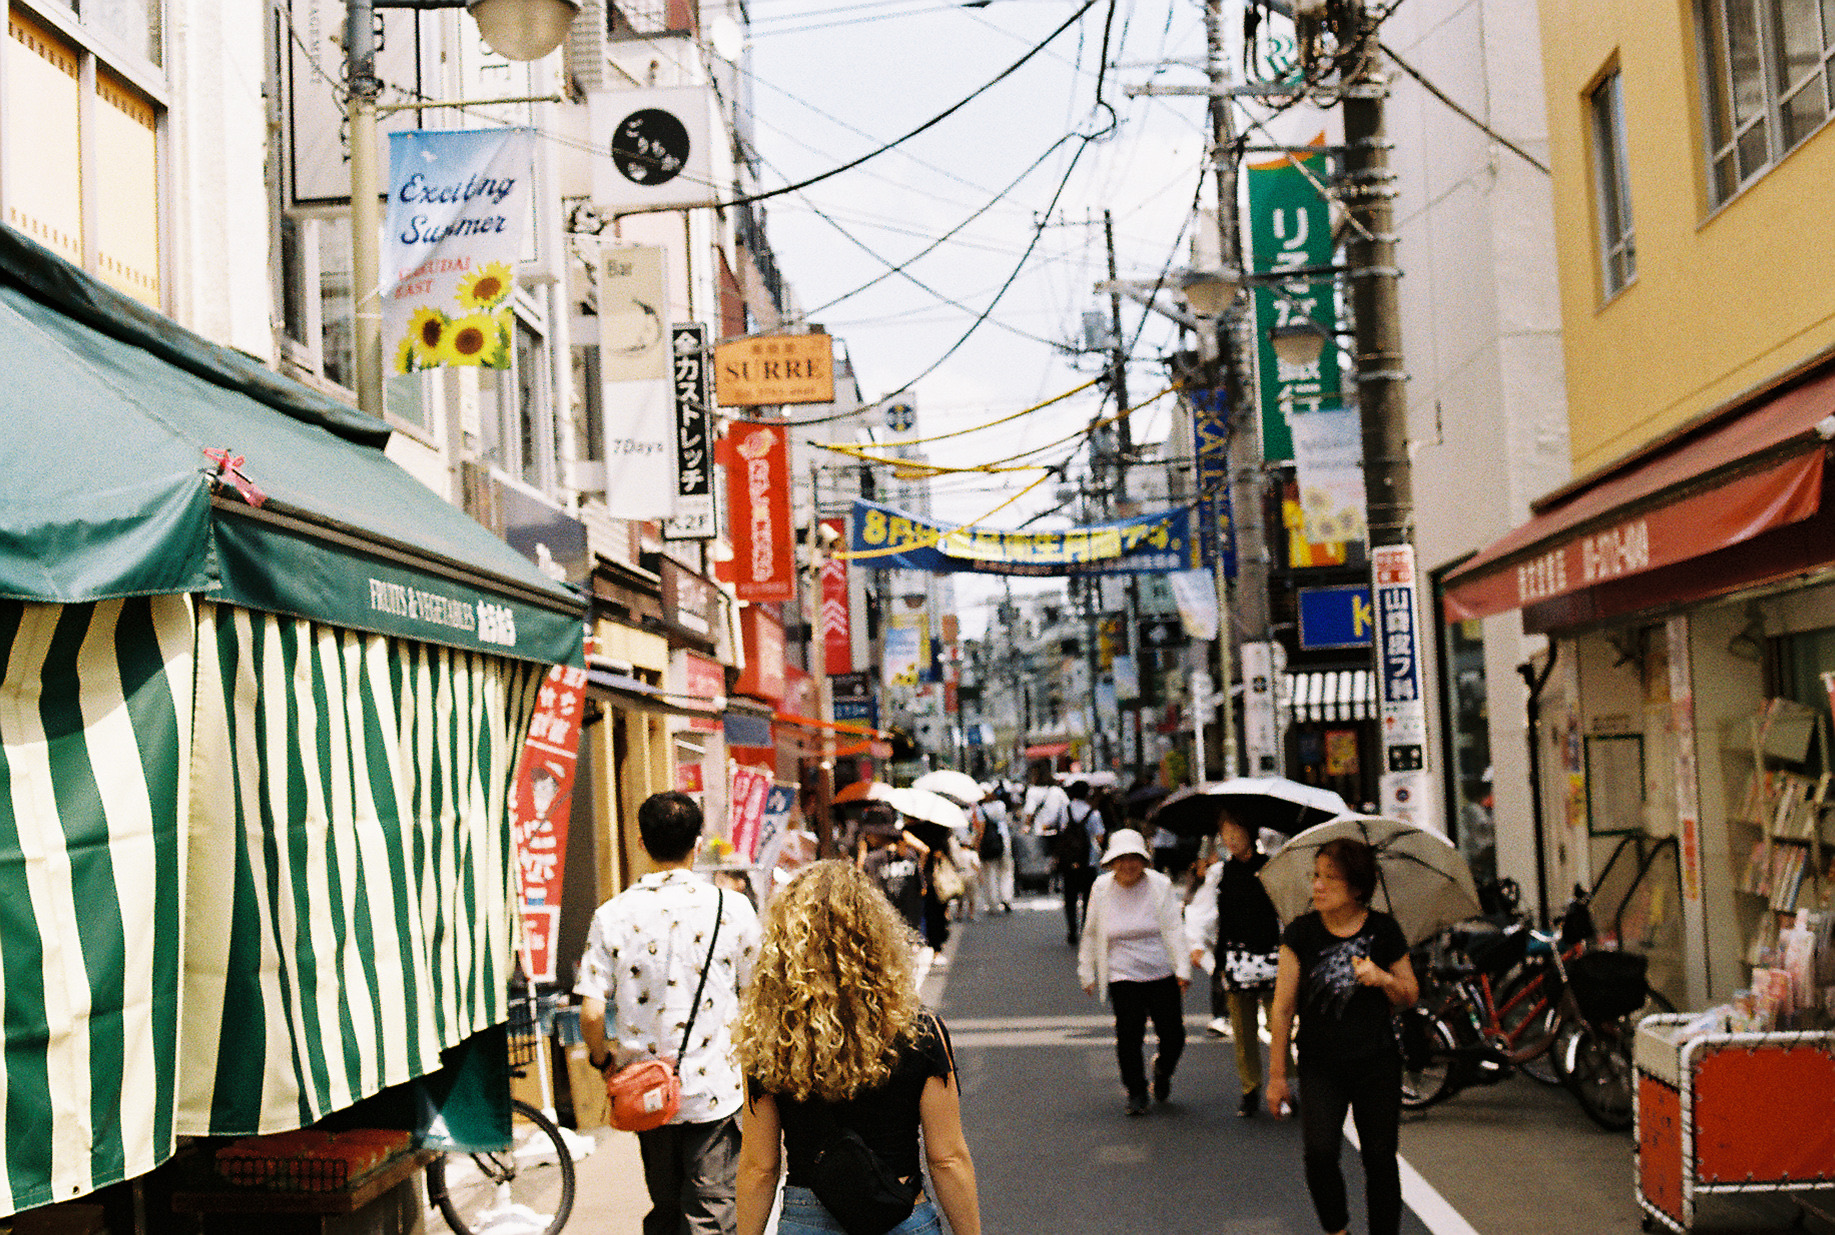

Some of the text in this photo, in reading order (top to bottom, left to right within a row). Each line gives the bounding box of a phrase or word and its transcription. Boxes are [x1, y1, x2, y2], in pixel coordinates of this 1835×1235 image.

[399, 172, 516, 204] Exciting
[400, 214, 506, 244] Summer
[607, 260, 632, 278] Bar
